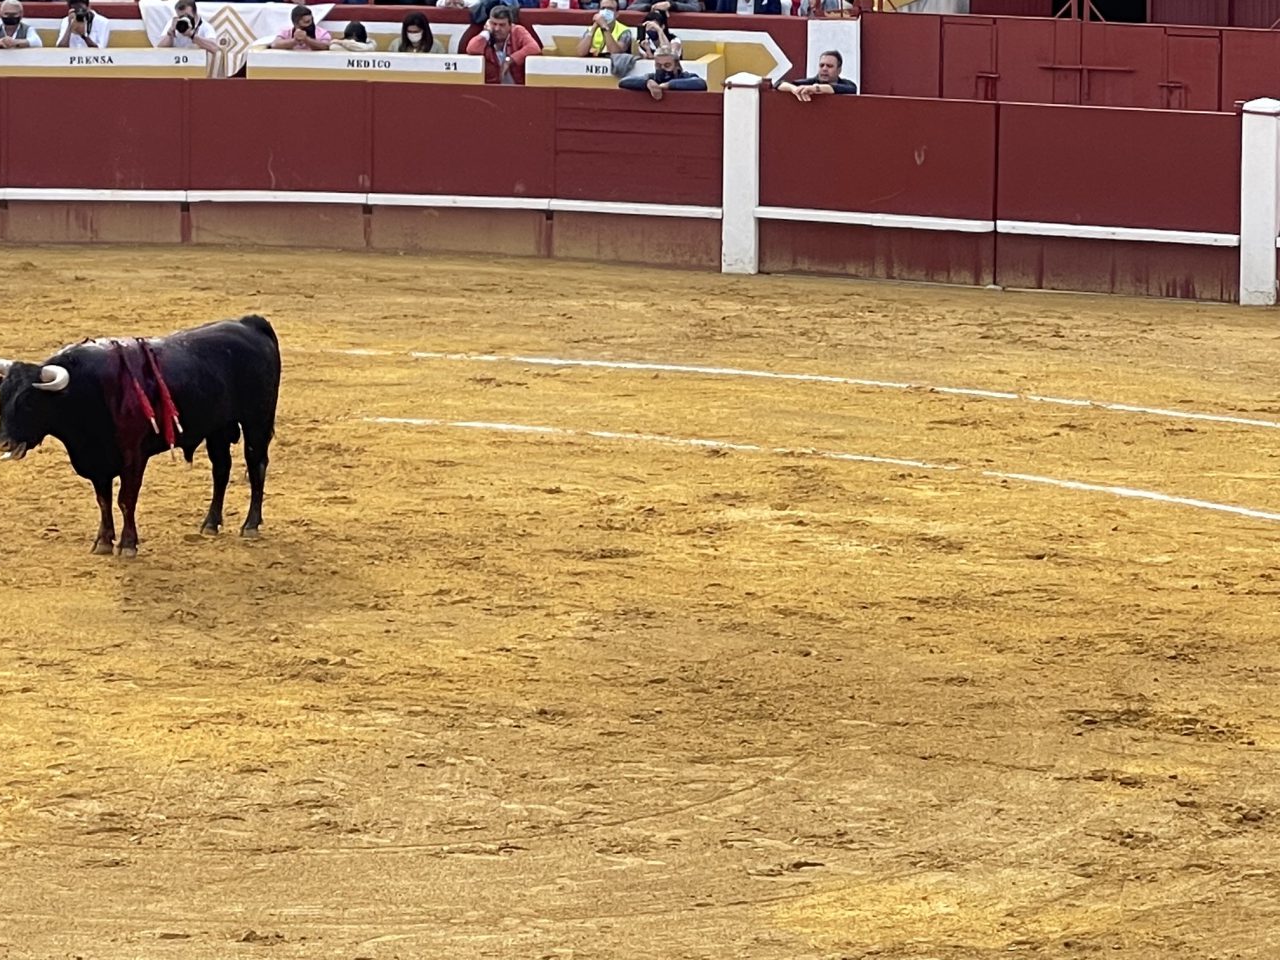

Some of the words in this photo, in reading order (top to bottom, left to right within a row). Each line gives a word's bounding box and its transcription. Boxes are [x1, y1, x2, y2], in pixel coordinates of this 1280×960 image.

[69, 55, 114, 65] PRENSA
[174, 55, 189, 65] 20
[346, 58, 391, 69] MEDICO
[444, 61, 458, 71] 21
